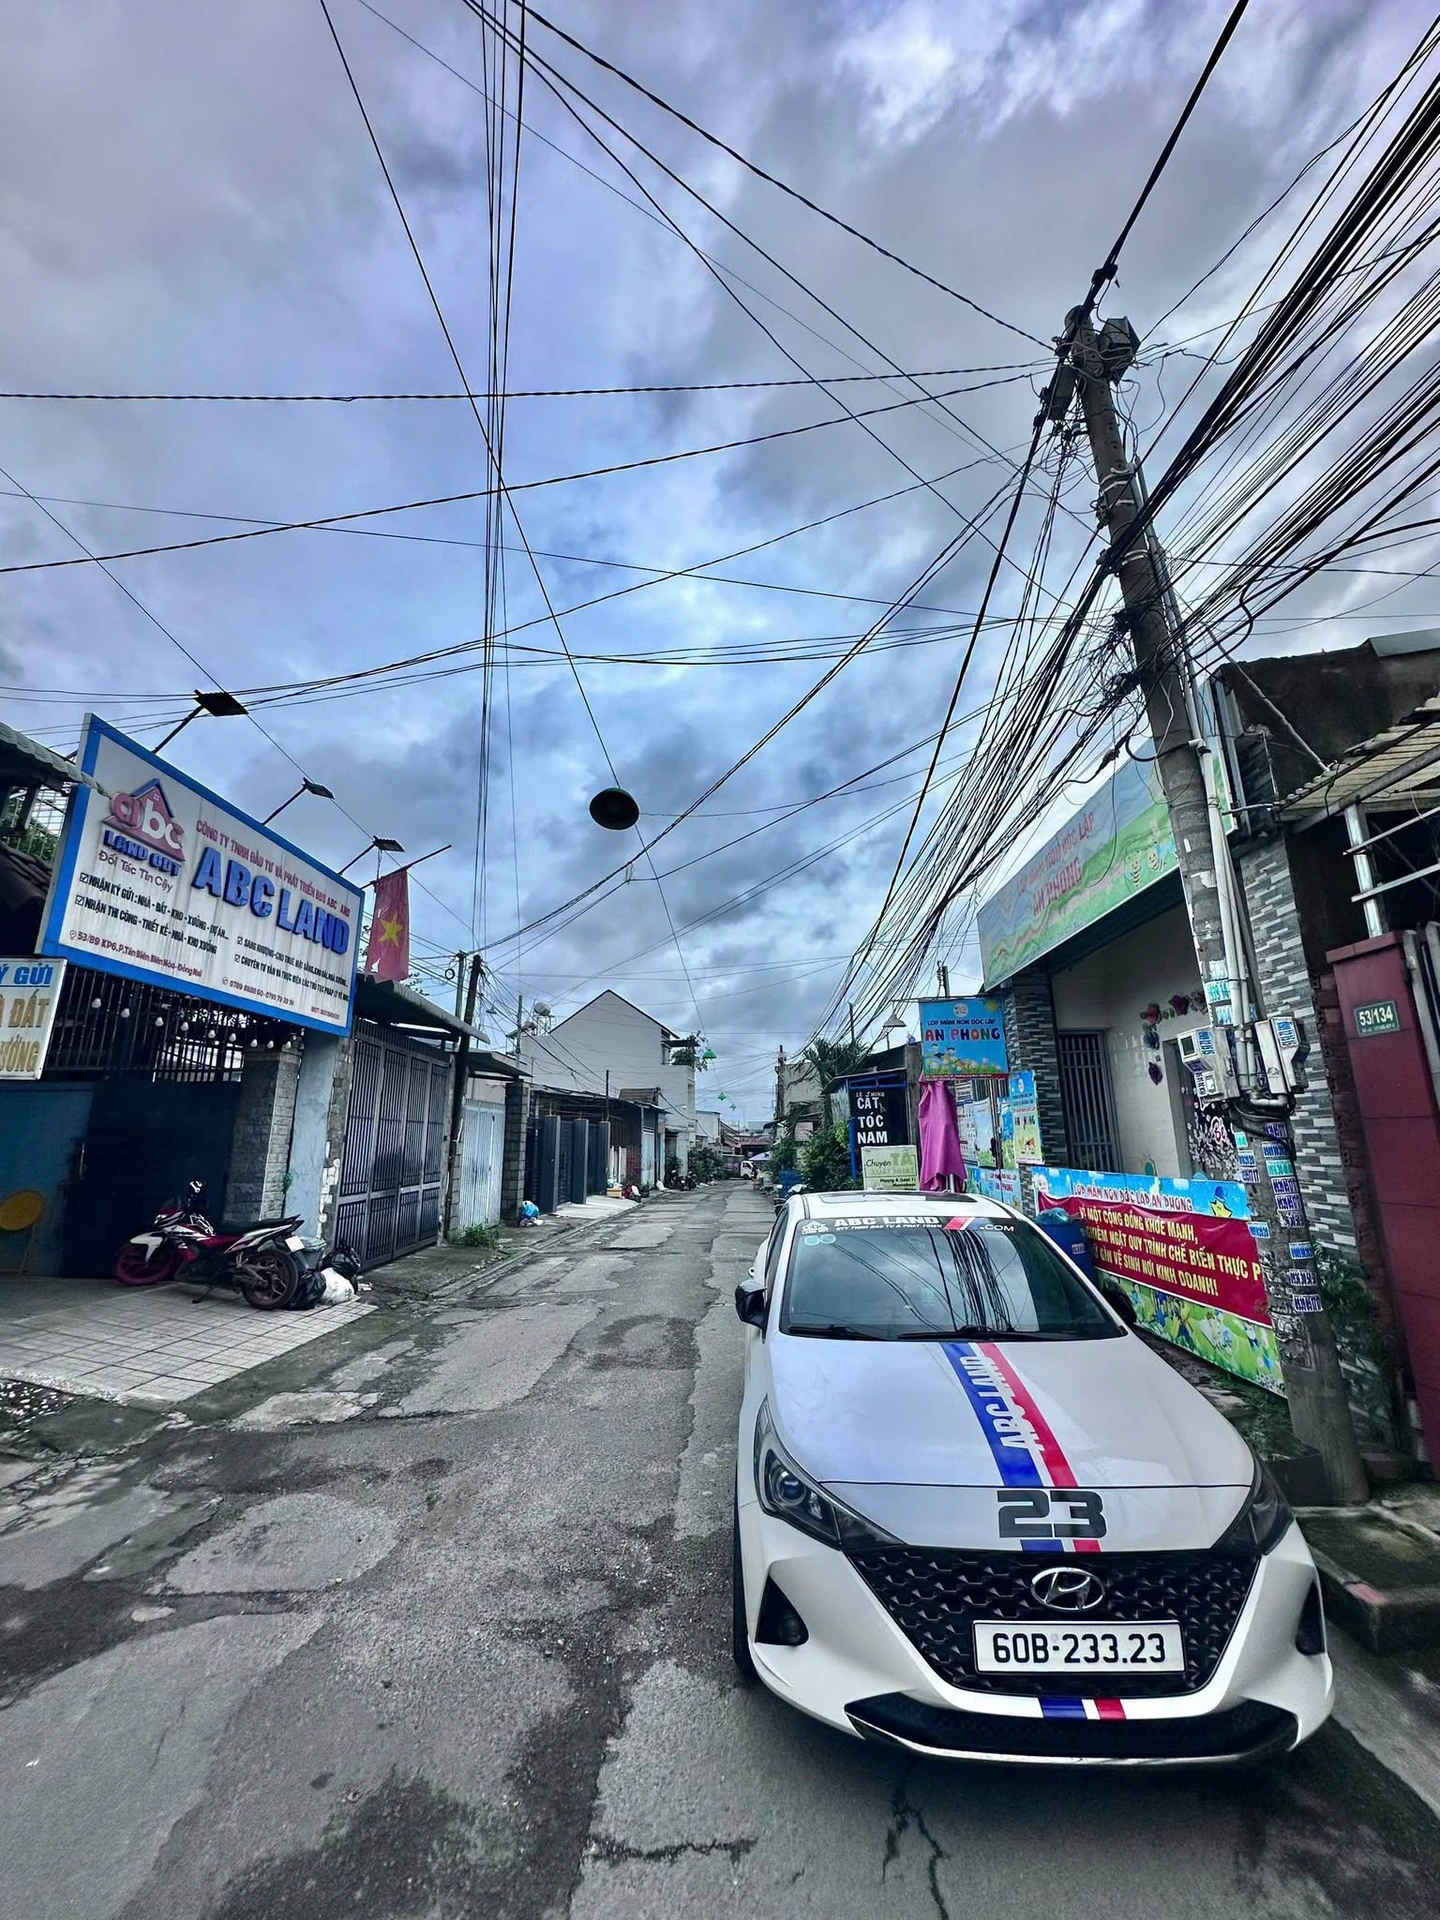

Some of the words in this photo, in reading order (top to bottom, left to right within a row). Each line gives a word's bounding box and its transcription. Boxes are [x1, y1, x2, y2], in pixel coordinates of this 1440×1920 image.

[103, 830, 148, 861] LAND
[98, 846, 118, 867] Đối
[119, 858, 137, 875] Tác
[153, 874, 173, 893] Cậy
[196, 819, 218, 842] CÔNG
[220, 833, 230, 848] TY
[265, 859, 275, 874] TƯ
[327, 898, 338, 910] ABC
[83, 894, 107, 915] NHẬN
[106, 905, 119, 918] THI
[118, 907, 138, 925] CÔNG
[88, 872, 111, 894] NHẬN
[110, 881, 121, 896] KÝ
[170, 907, 183, 921] KHO
[192, 847, 275, 918] ABC
[276, 888, 350, 955] LAND
[77, 930, 100, 946] 53/89
[14, 963, 54, 985] GỬI
[8, 988, 50, 1028] ĐẤT
[1359, 1005, 1394, 1026] 53/134
[925, 1028, 945, 1041] AN
[950, 1027, 1001, 1041] PHONG
[856, 1091, 879, 1110] CẮT
[857, 1112, 884, 1129] TÓC
[856, 1131, 888, 1145] NAM
[865, 1159, 892, 1169] Chuyên
[834, 1217, 876, 1227] ABC
[882, 1216, 940, 1225] LAND
[1086, 1207, 1101, 1224] MỘT
[1102, 1209, 1123, 1227] CỘNG
[1124, 1211, 1144, 1231] ĐỒNG
[1145, 1215, 1166, 1235] KHỎE
[1109, 1230, 1127, 1250] NGẶT
[1128, 1233, 1142, 1251] QUY
[1143, 1236, 1167, 1257] TRÌNH
[1168, 1242, 1187, 1262] CHẾ
[1190, 1245, 1215, 1270] BIẾN
[1217, 1254, 1249, 1280] THỰC
[1114, 1249, 1123, 1269] VỆ
[1124, 1256, 1141, 1271] SINH
[1156, 1265, 1178, 1284] KINH
[959, 1355, 1017, 1398] LAND
[986, 1402, 1045, 1451] ABC
[997, 1490, 1107, 1538] 23
[993, 1633, 1165, 1664] 60B-233.23
